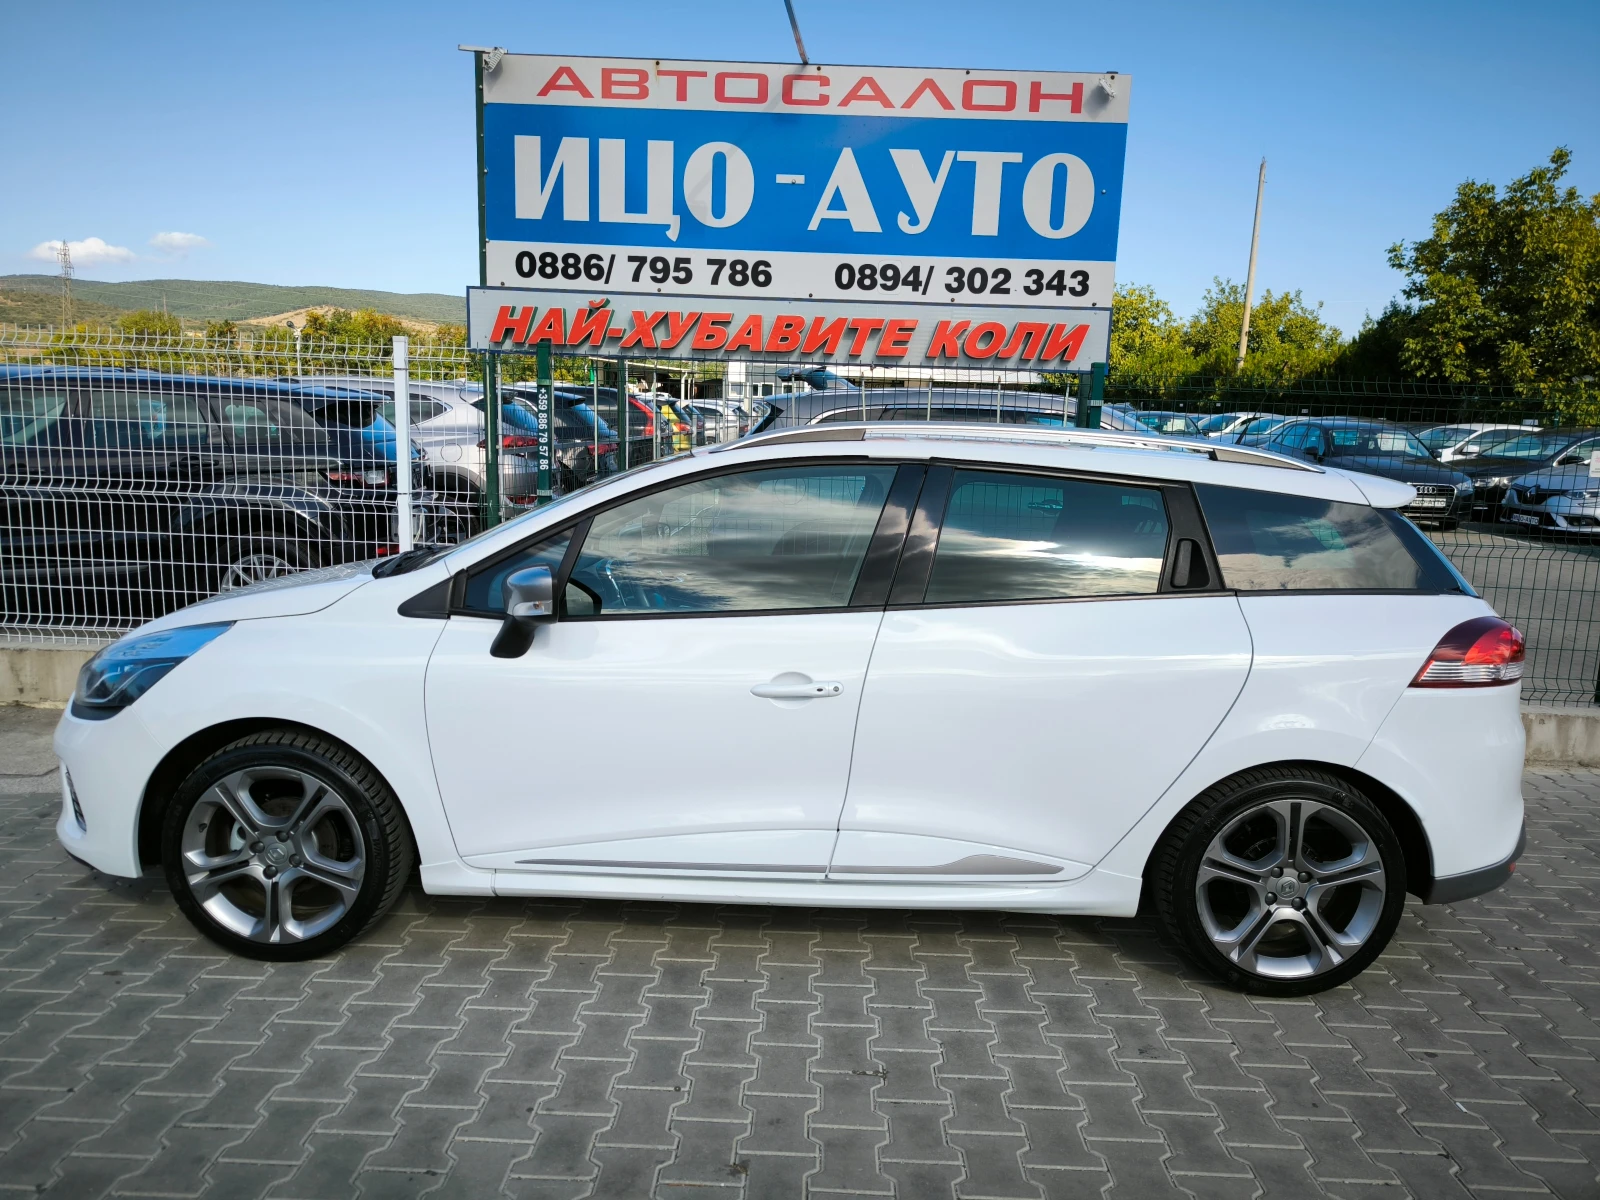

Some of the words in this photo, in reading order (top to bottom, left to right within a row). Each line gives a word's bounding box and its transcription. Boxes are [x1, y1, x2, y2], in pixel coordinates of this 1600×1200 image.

[536, 66, 1084, 114] АВТОСАЛОН
[515, 250, 616, 285] 0886/
[627, 255, 693, 284] 795
[706, 258, 773, 288] 786
[834, 262, 935, 296] 0894/
[944, 266, 1012, 296] 302
[1022, 268, 1090, 297] 343
[489, 297, 919, 357] НАЙ-ХУБАВИТЕ
[926, 319, 1091, 361] КОЛИ
[538, 387, 548, 411] +359
[538, 412, 548, 430] 886
[538, 431, 549, 443] 79
[538, 445, 549, 457] 57
[539, 458, 549, 470] 86
